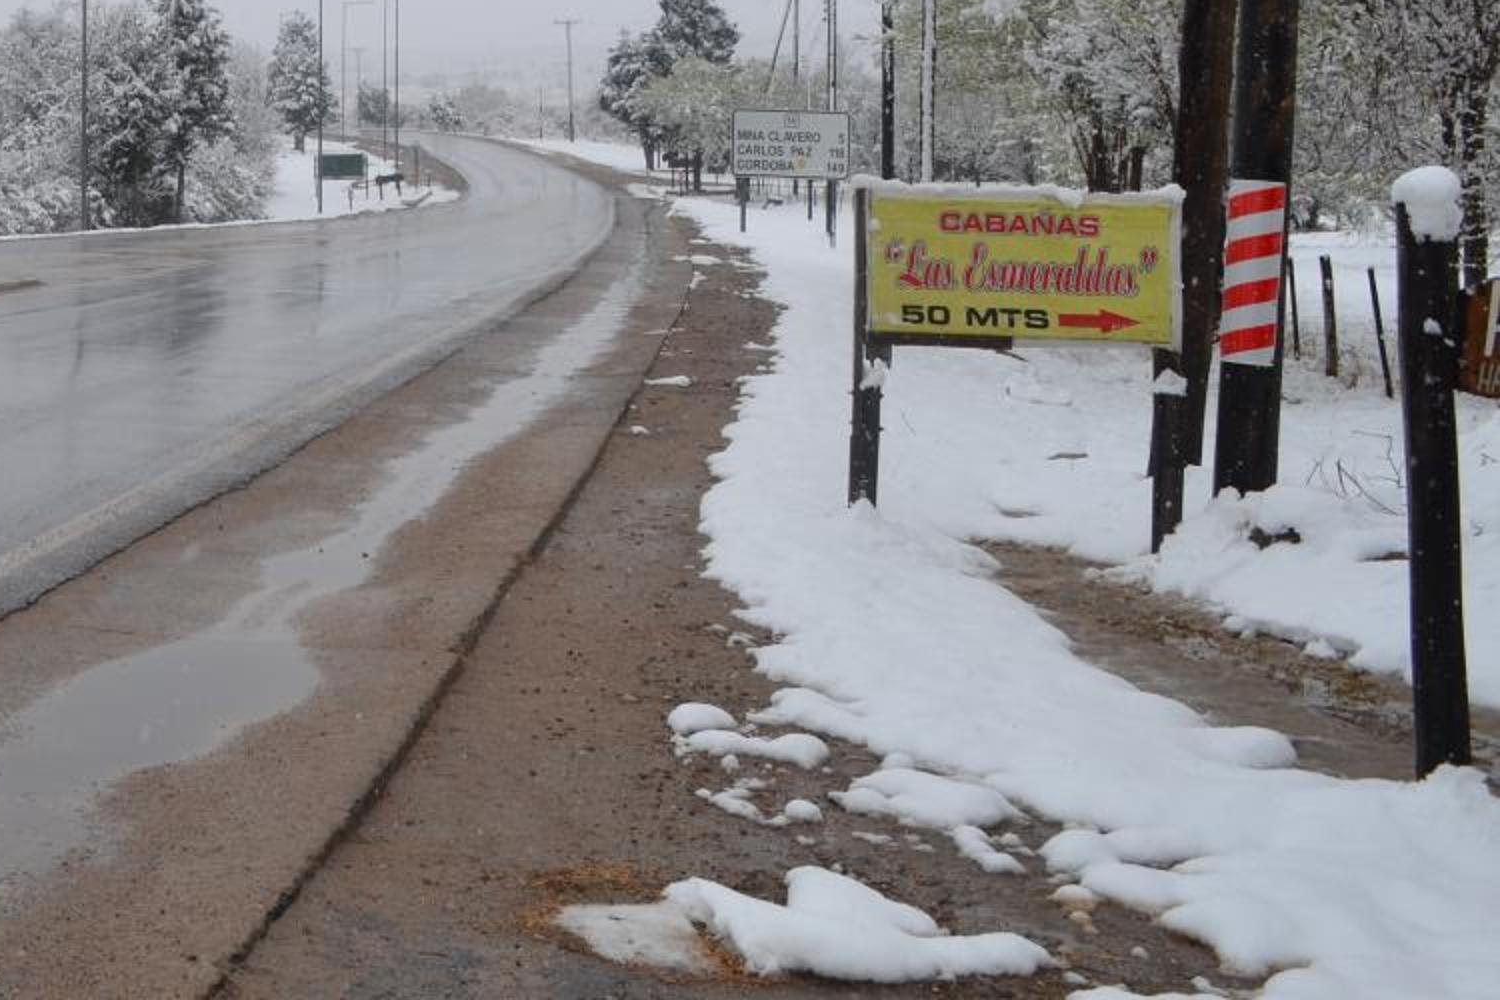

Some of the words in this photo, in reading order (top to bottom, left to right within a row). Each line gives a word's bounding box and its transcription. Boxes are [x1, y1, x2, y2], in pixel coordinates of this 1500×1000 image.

[737, 130, 765, 141] MINA
[767, 131, 821, 143] CLAVERO
[738, 145, 783, 157] CARLOS
[737, 160, 794, 171] CORDOBA
[901, 305, 950, 325] 50
[965, 307, 1049, 329] MTS
